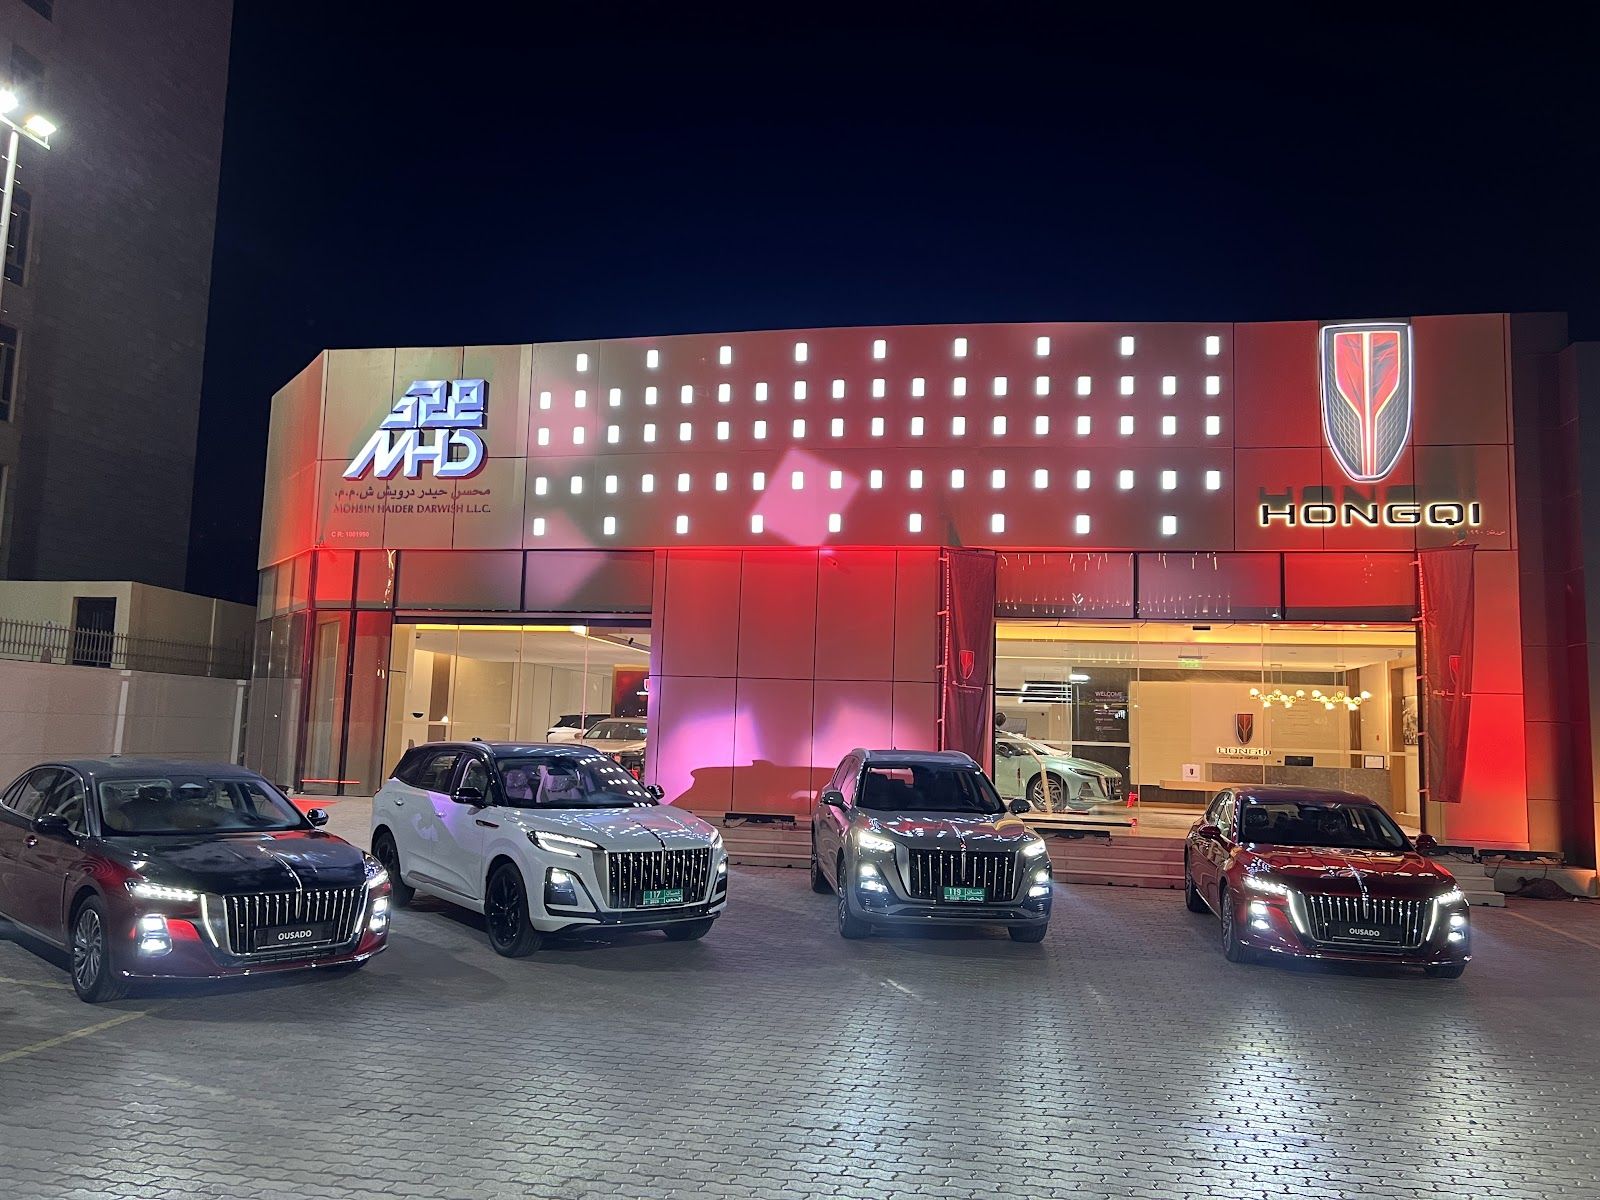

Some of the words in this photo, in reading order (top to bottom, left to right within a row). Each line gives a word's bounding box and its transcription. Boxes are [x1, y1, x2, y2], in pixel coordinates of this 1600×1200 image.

[342, 428, 486, 478] MHD
[376, 485, 415, 500] درويش
[417, 487, 448, 499] حيدر
[451, 487, 491, 500] محسن
[333, 503, 375, 514] MOHSIN
[377, 503, 414, 514] HAIDER
[416, 503, 464, 514] DARWISH
[466, 503, 491, 513] L.L.C.
[1261, 502, 1481, 526] HONGQI
[649, 890, 661, 899] 117
[277, 929, 312, 941] OUSADO
[1348, 927, 1380, 937] OUSADO
